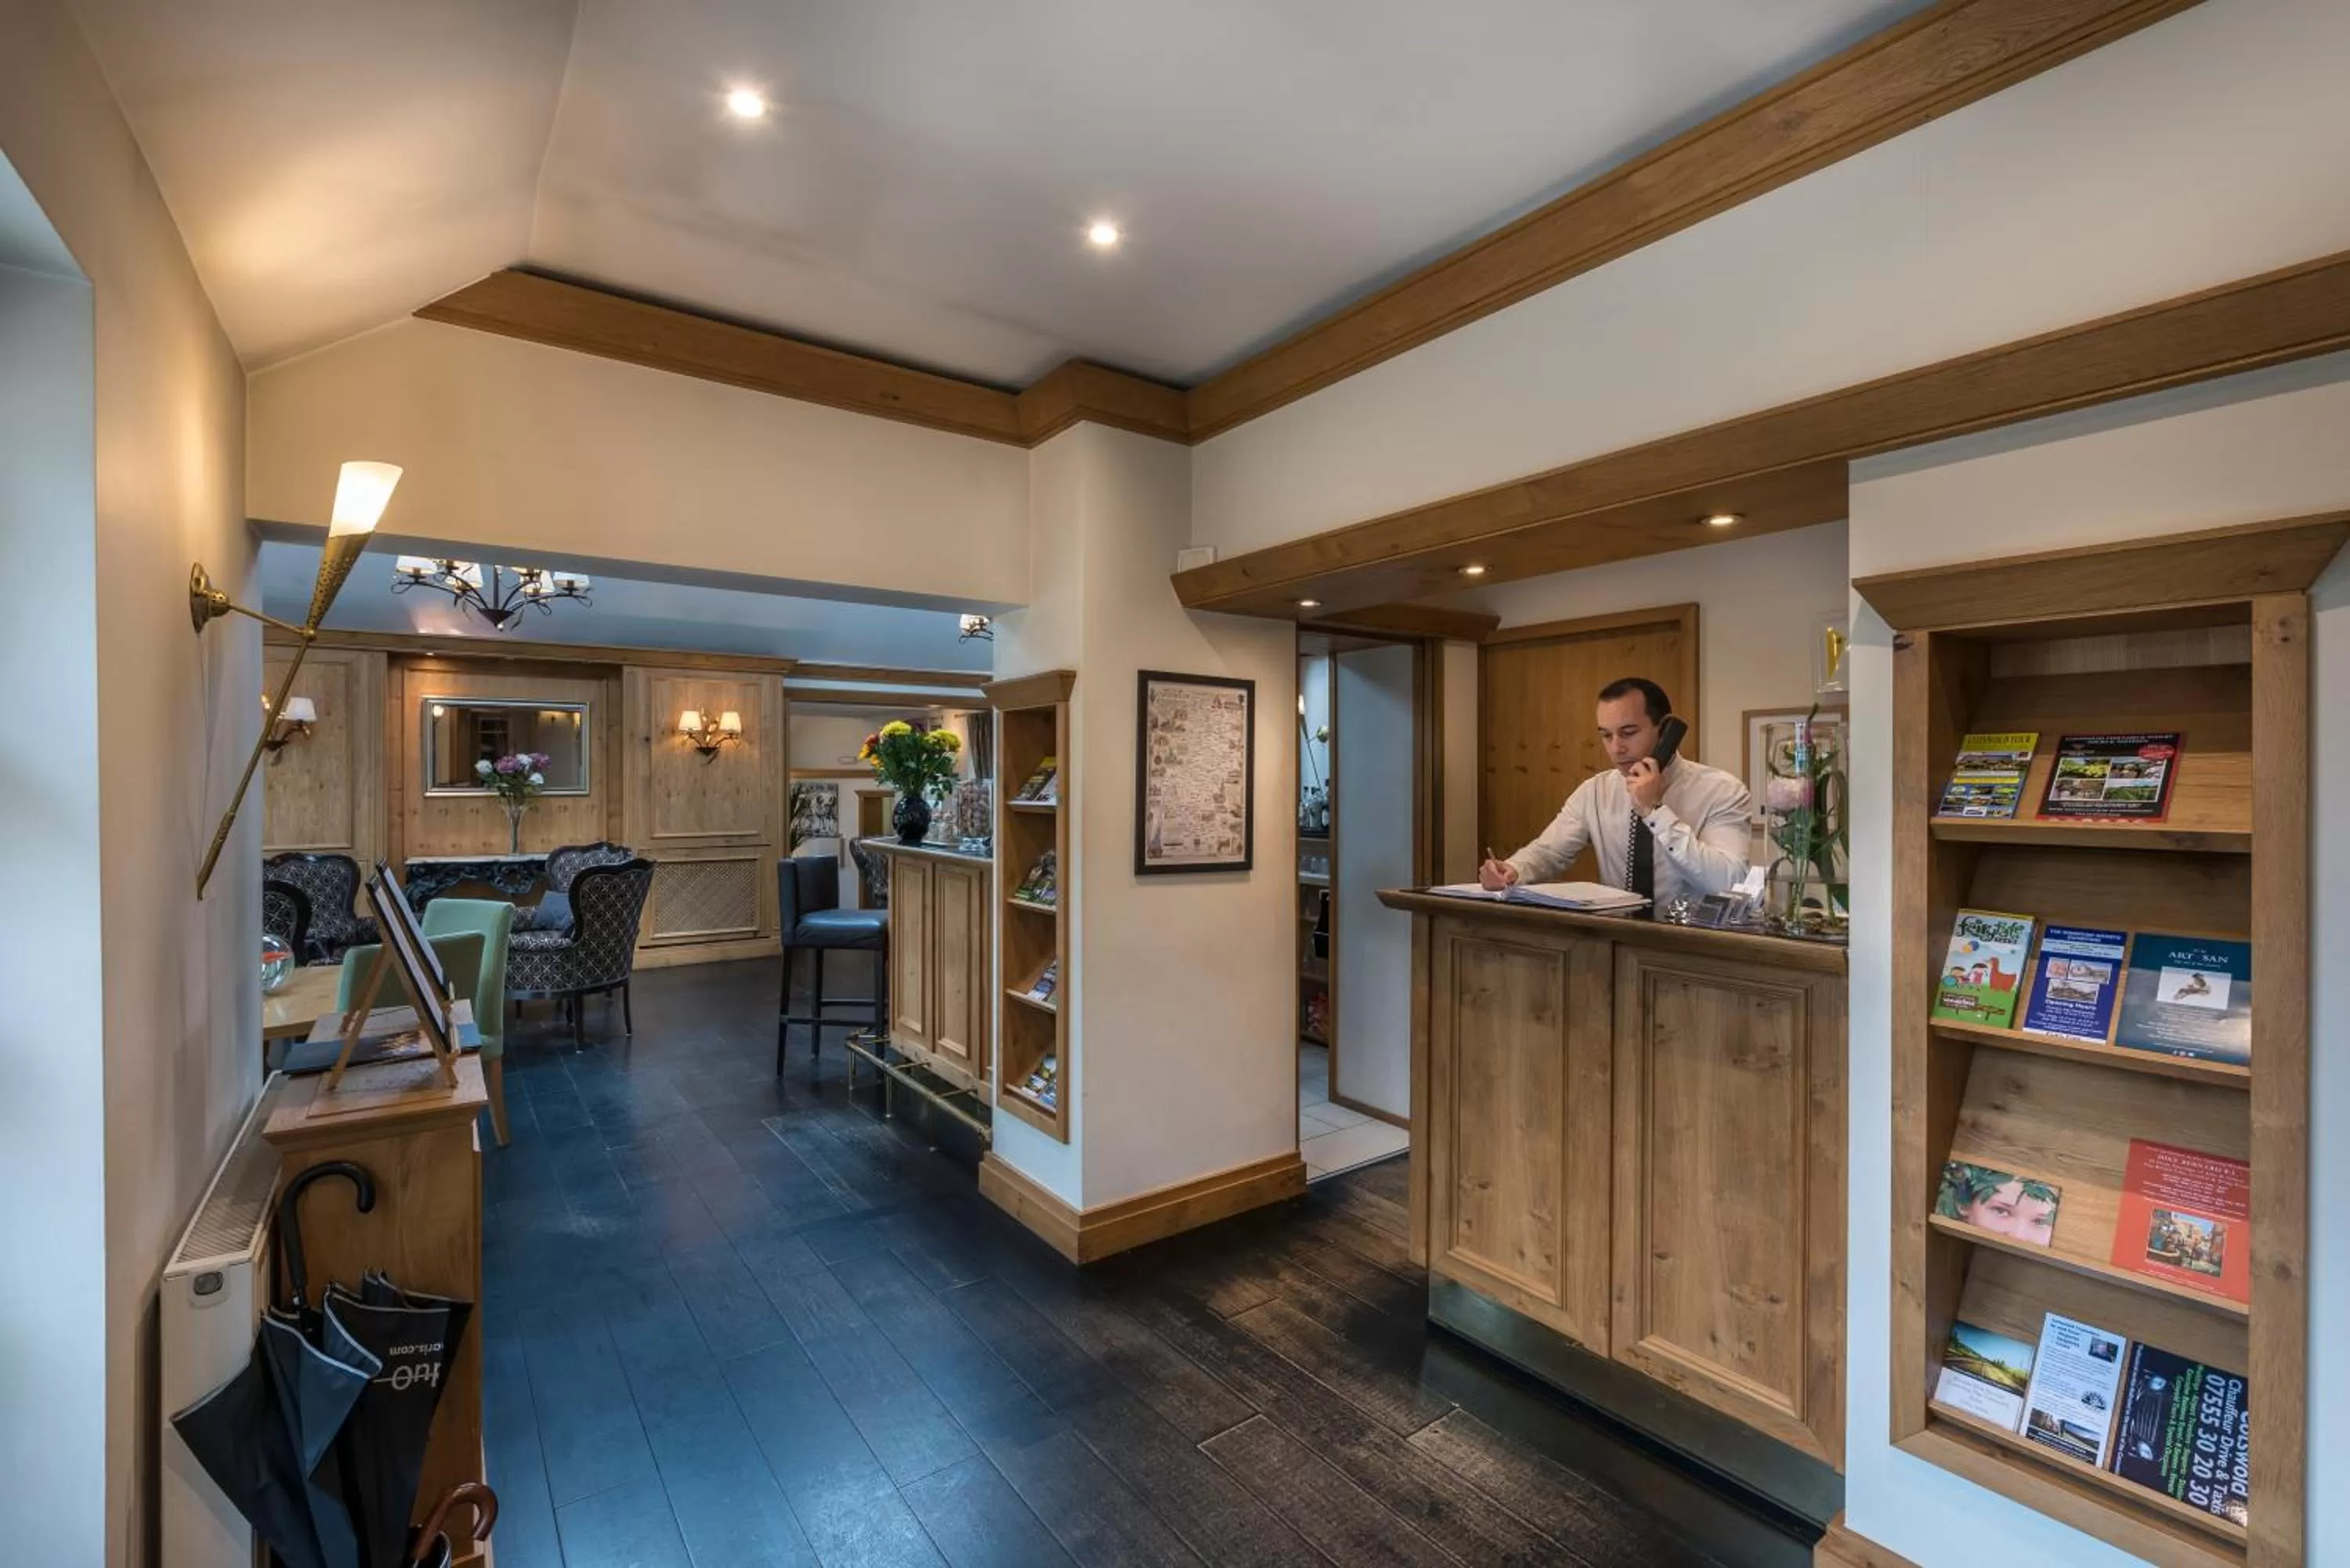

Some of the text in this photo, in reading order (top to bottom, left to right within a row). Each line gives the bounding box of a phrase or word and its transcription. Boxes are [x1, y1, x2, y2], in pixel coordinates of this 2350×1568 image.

[2167, 951, 2229, 963] ARTSAN
[2188, 1374, 2225, 1506] 07555 30 20 30
[2210, 1379, 2242, 1515] Chauffeur Drive & Taxis
